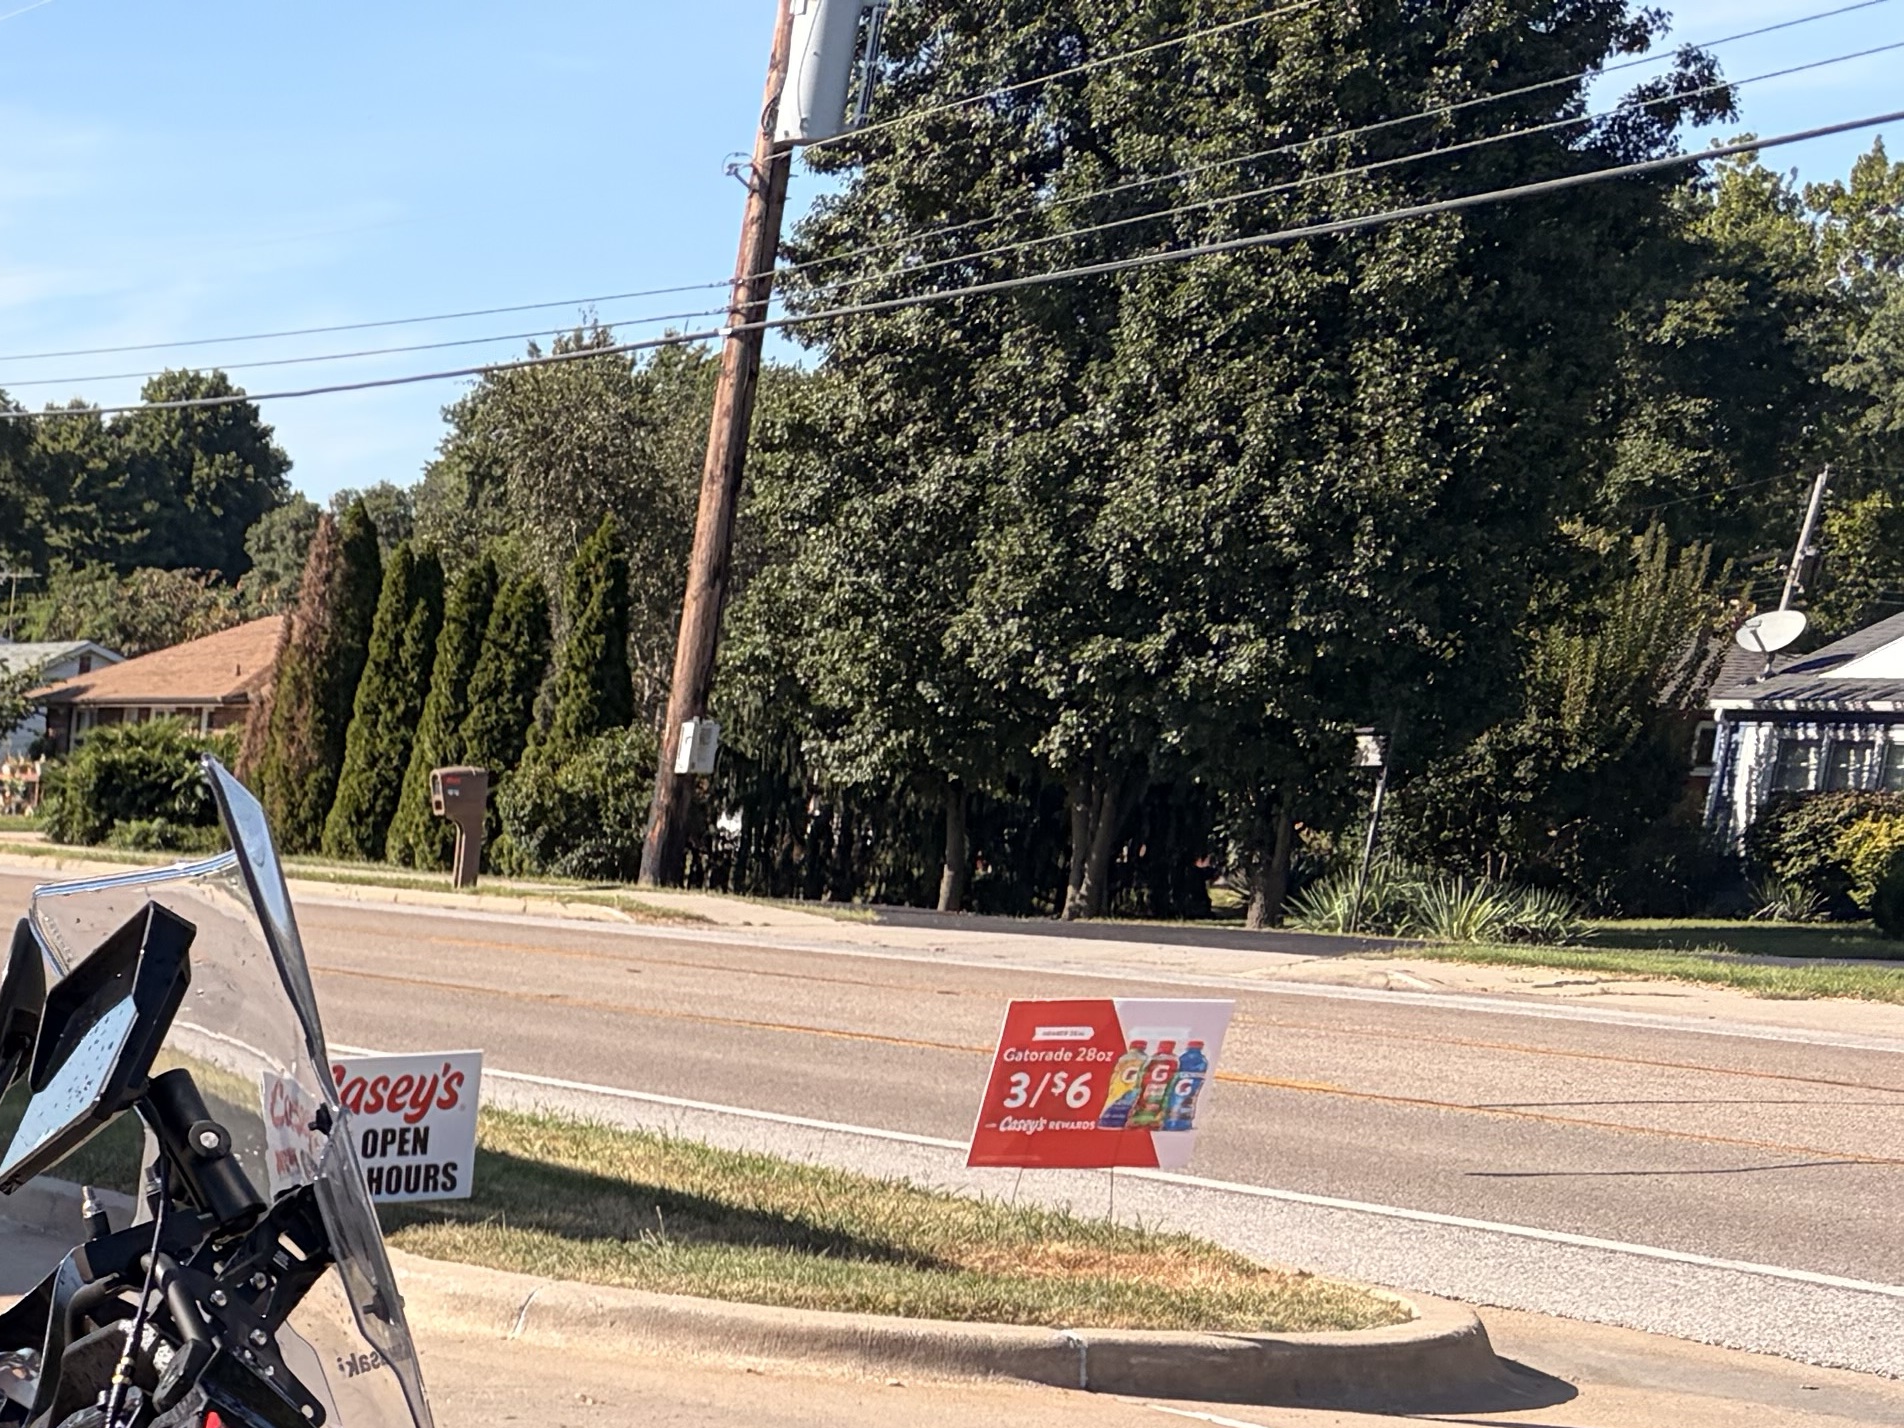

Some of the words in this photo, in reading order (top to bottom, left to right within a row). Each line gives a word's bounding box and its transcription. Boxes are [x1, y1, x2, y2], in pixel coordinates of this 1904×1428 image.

[1002, 1046, 1073, 1063] Gatorade
[1074, 1046, 1115, 1063] 28oz
[998, 1114, 1048, 1136] Casey's
[1048, 1119, 1096, 1131] REWARDS
[360, 1126, 431, 1159] OPEN
[366, 1161, 459, 1196] HOURS
